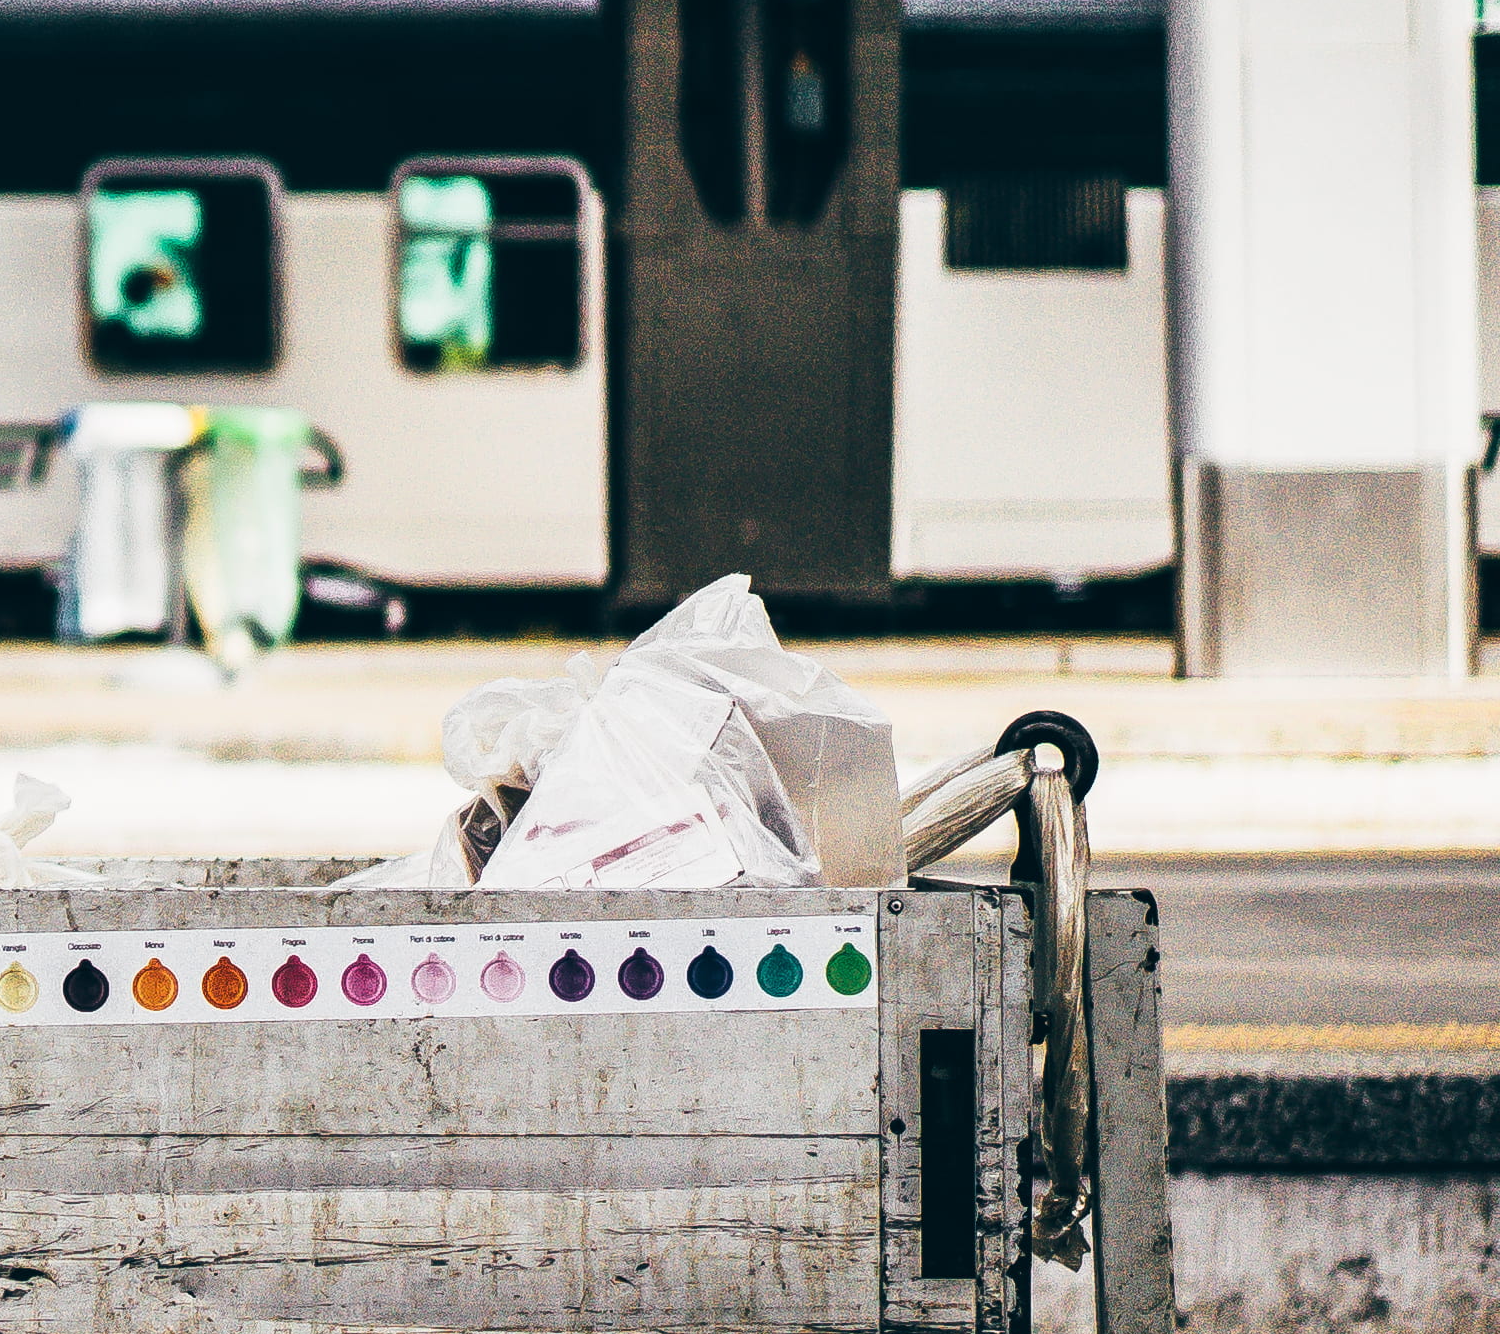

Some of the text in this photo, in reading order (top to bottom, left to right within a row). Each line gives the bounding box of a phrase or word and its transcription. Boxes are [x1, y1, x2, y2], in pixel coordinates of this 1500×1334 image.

[409, 934, 424, 943] Fiori
[425, 934, 433, 943] di
[479, 933, 494, 942] Fiori
[494, 933, 502, 942] di
[1, 943, 28, 954] Vaniglia
[212, 939, 236, 950] Mango
